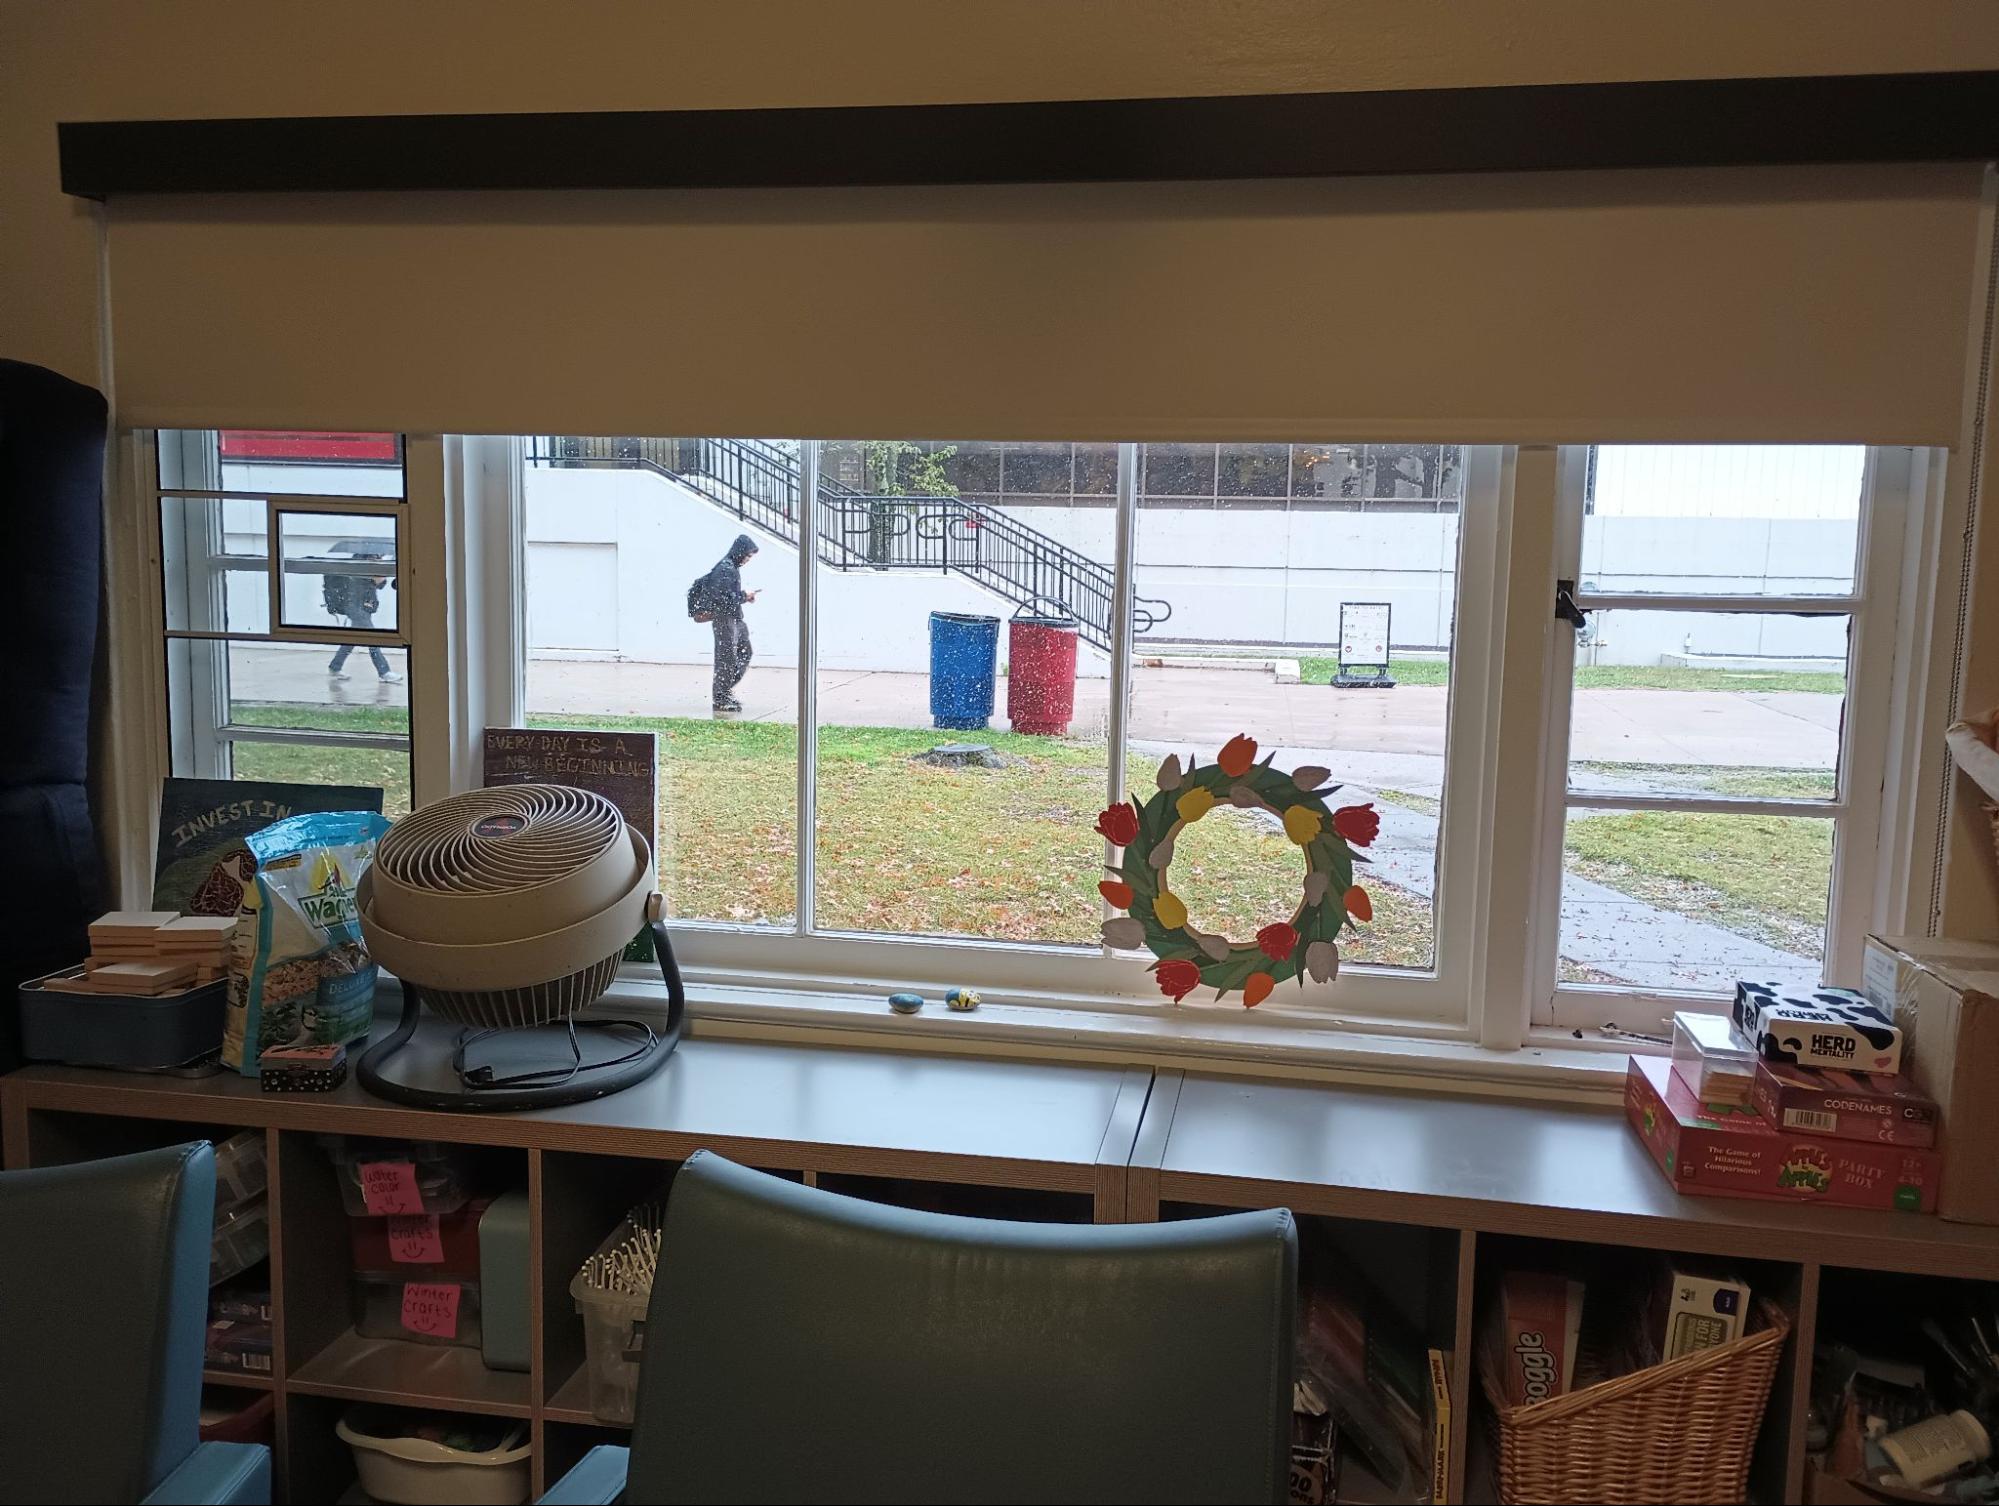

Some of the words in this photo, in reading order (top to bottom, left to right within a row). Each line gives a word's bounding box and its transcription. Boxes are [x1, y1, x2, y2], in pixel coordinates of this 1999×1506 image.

[541, 736, 571, 753] DAY
[576, 737, 602, 754] IS
[615, 738, 633, 756] A
[171, 799, 254, 848] INVEST
[258, 800, 292, 820] IN
[1811, 1033, 1856, 1052] HERD
[1810, 1048, 1856, 1060] MENTALITY
[1823, 1098, 1893, 1116] CODENAMES
[1708, 1145, 1724, 1154] The
[1726, 1148, 1750, 1157] Game
[1752, 1151, 1762, 1159] of
[1715, 1155, 1752, 1166] Hilarious
[1704, 1162, 1761, 1175] Comparisons!
[1838, 1158, 1886, 1179] PARTY
[1845, 1172, 1872, 1190] BOX
